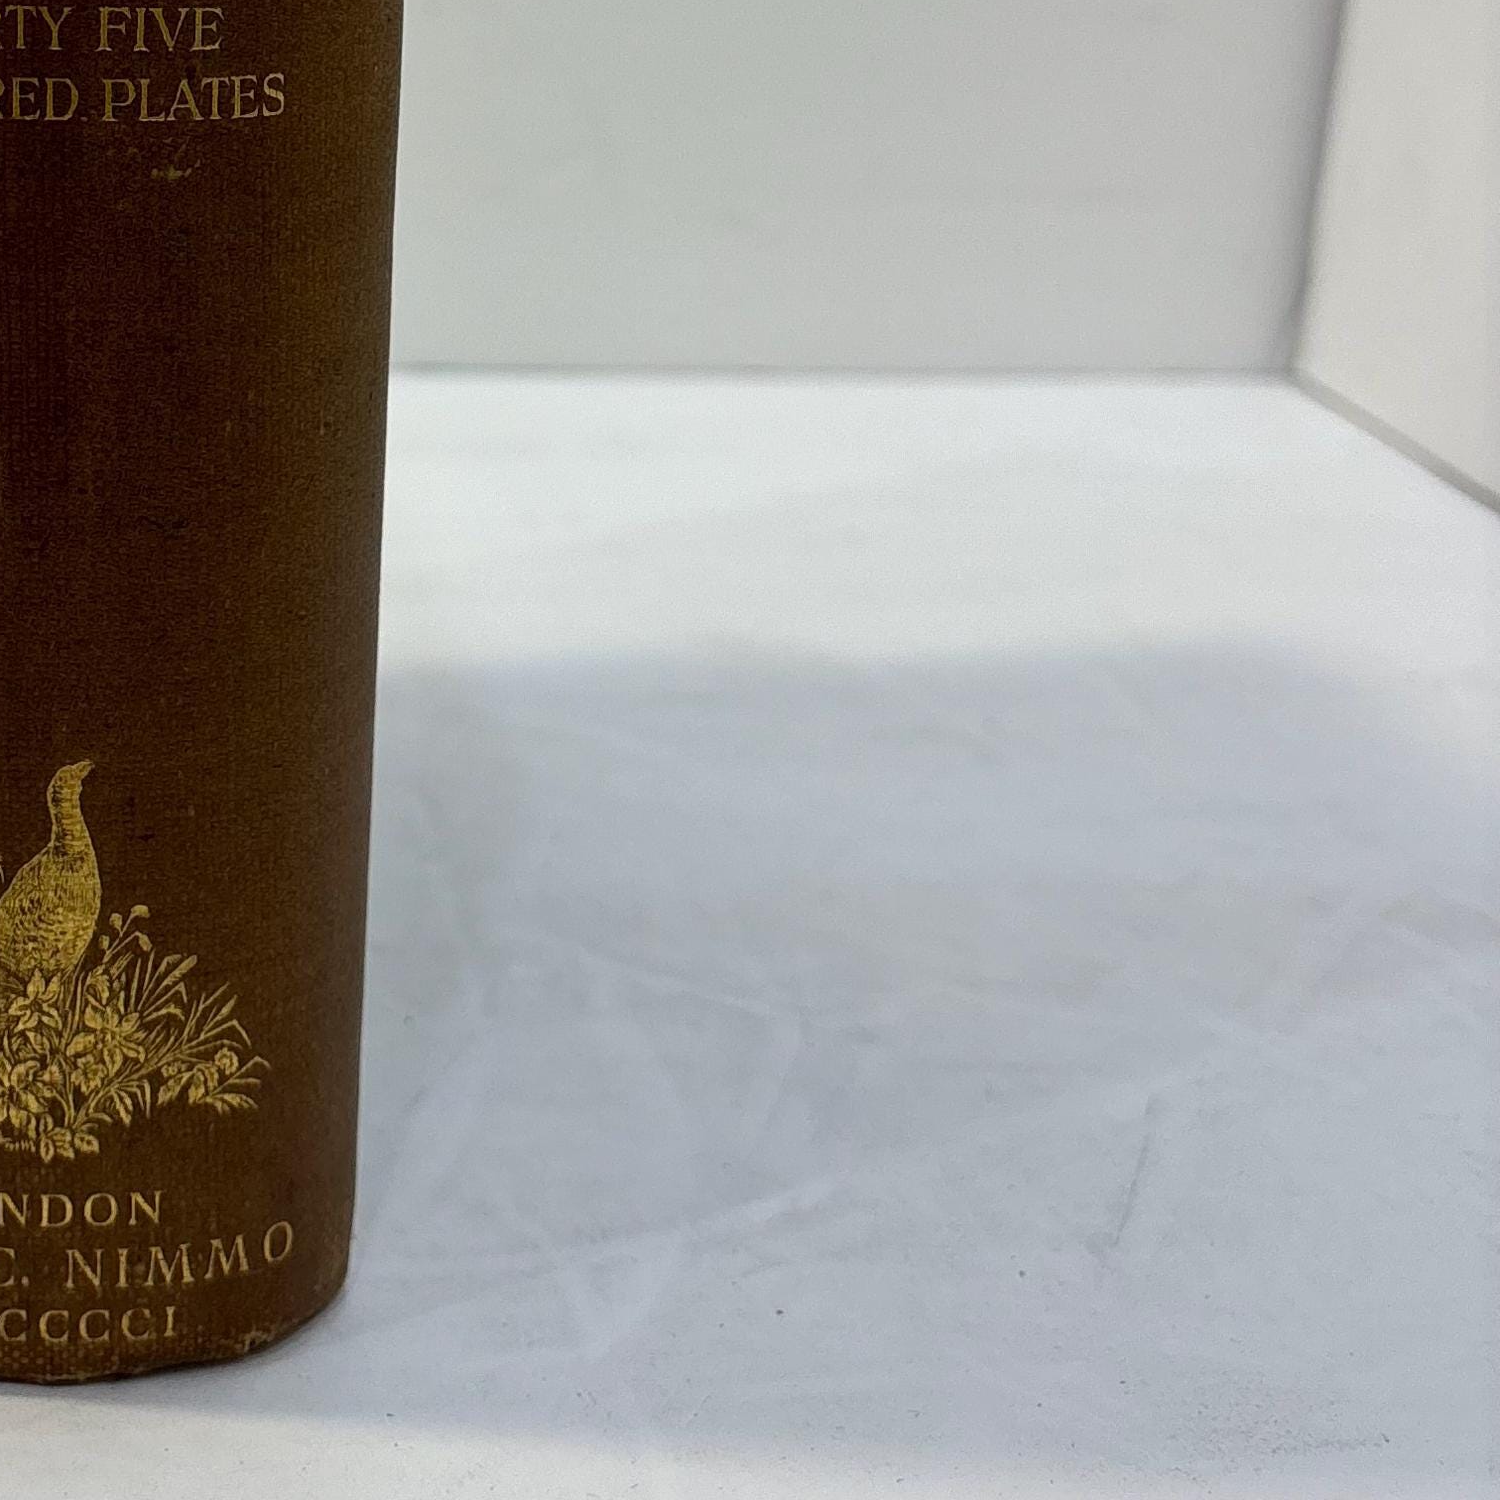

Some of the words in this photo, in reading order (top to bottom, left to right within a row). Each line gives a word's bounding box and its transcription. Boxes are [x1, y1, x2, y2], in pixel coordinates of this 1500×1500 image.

[95, 6, 225, 52] FIVE
[101, 72, 285, 122] PLATES
[65, 1220, 294, 1289] NIMMO
